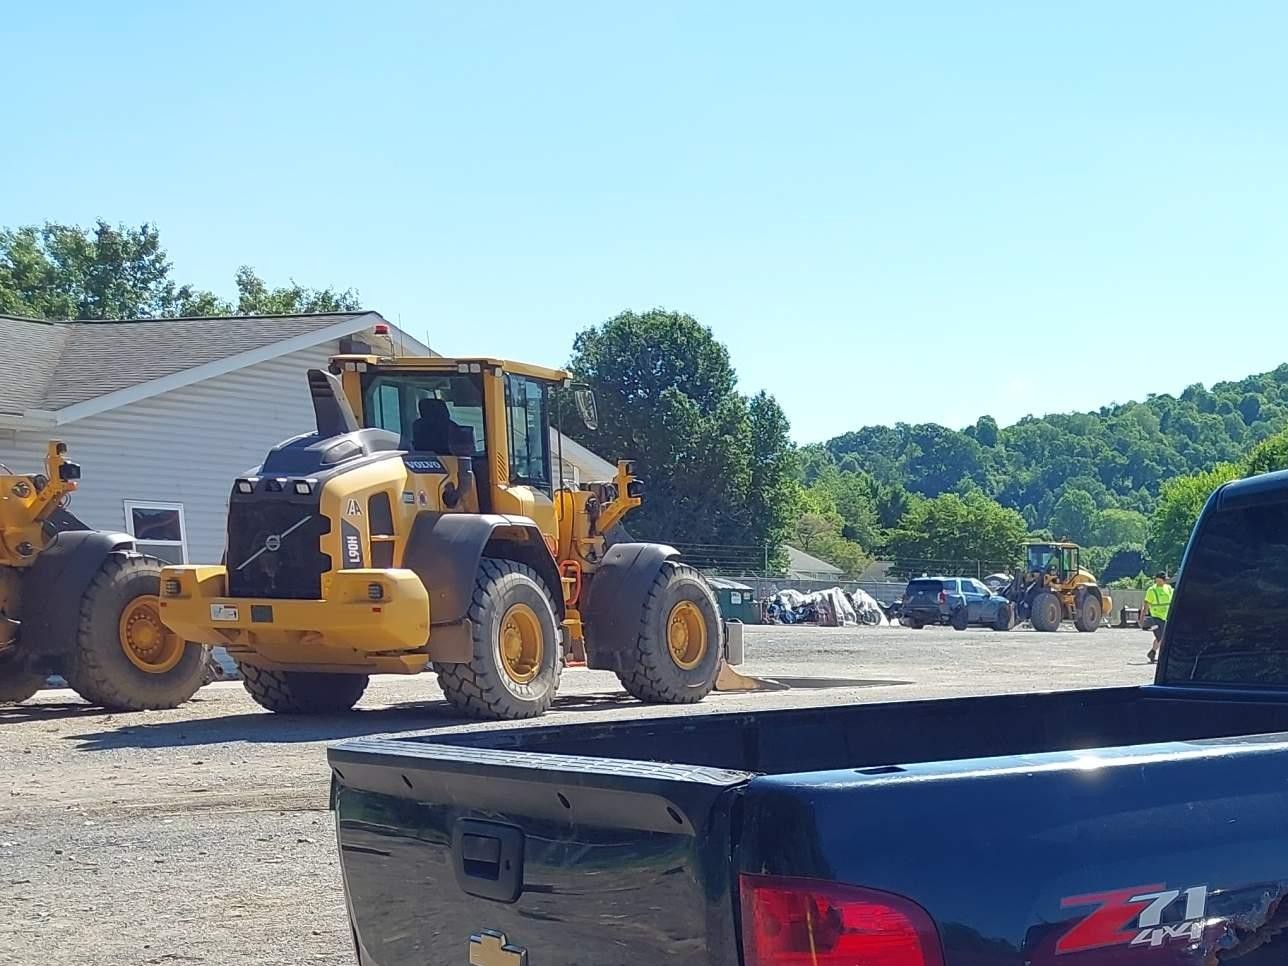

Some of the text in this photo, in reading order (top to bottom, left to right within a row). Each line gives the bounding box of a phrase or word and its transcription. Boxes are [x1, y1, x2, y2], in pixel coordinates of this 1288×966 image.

[405, 460, 441, 469] VOLVO
[345, 535, 361, 563] L90H
[1056, 883, 1208, 954] Z71
